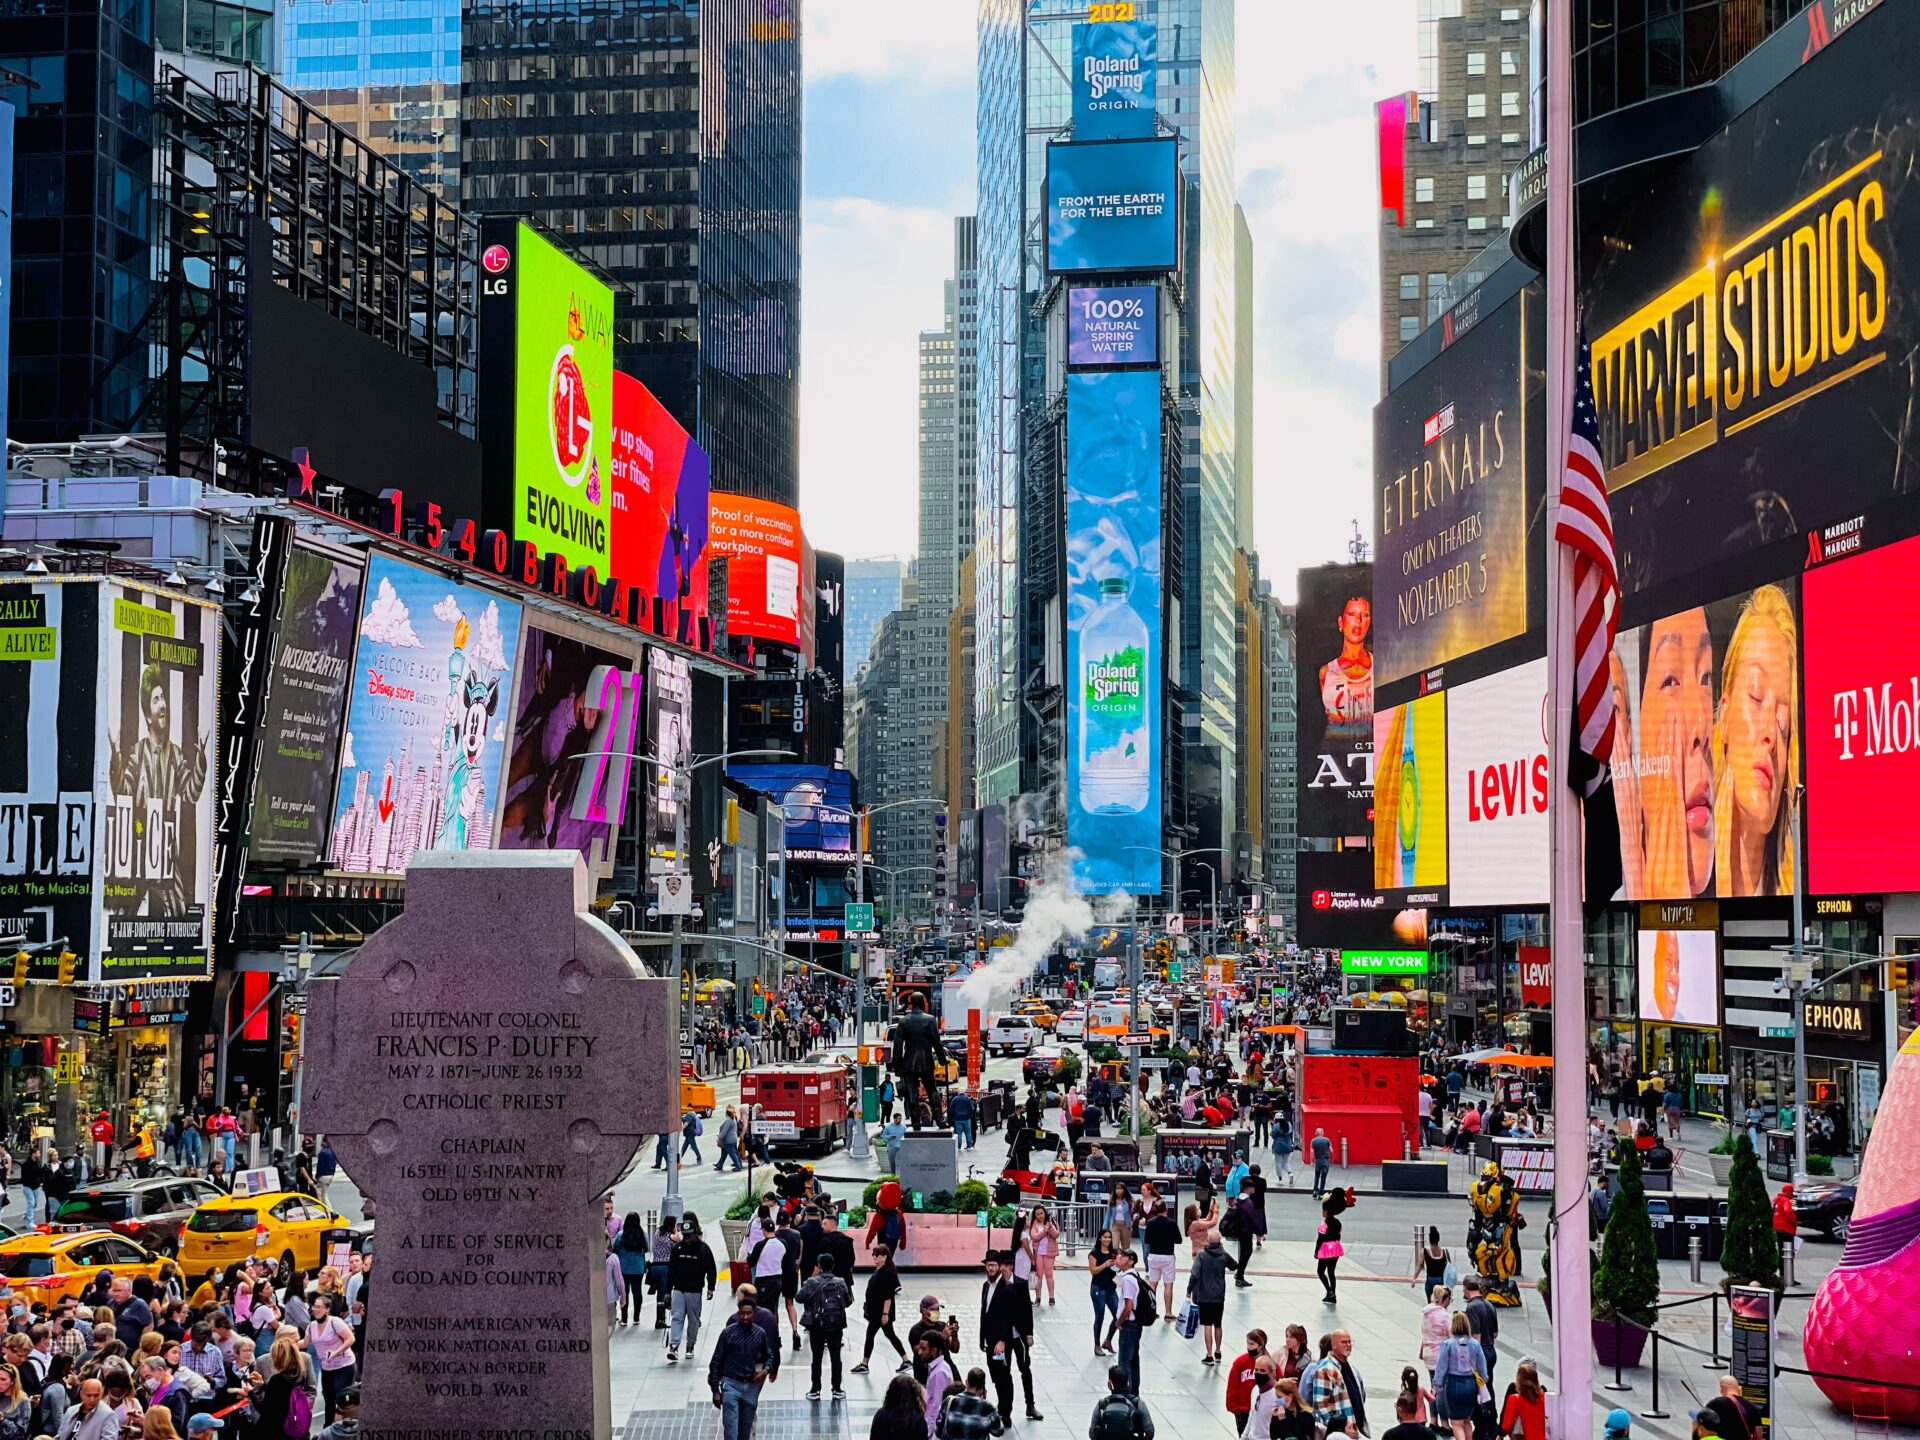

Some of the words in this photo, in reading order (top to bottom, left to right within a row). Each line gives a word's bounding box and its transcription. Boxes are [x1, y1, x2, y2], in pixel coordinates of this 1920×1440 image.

[1088, 2, 1134, 23] 2021
[1084, 53, 1139, 83] Poland
[1090, 70, 1143, 99] Spring
[1088, 100, 1139, 111] ORIGIN
[1058, 196, 1094, 208] FROM
[1096, 195, 1121, 206] THE
[1124, 193, 1165, 205] EARTH
[1060, 207, 1087, 219] FOR
[1089, 206, 1114, 218] THE
[1116, 205, 1163, 217] BETTER
[483, 279, 508, 295] LG
[1454, 289, 1481, 316] MARRIOTT
[1723, 181, 1886, 412] STUDIOS
[1082, 299, 1144, 320] 100%
[1085, 321, 1140, 333] NATURAL
[1454, 310, 1478, 335] MARQUIS
[1091, 331, 1134, 343] SPRING
[1092, 342, 1134, 353] WATER
[1596, 288, 1714, 473] MARVEL
[620, 429, 635, 451] up
[635, 432, 654, 464] strong
[1382, 410, 1504, 537] ETERNALS
[527, 486, 605, 555] EVOLVING
[711, 506, 741, 522] Proof
[743, 511, 753, 523] of
[755, 515, 793, 533] vaccination
[1825, 516, 1864, 540] MARRIOTT
[711, 522, 727, 535] for
[729, 526, 737, 536] a
[739, 528, 764, 541] more
[765, 530, 794, 548] confident
[1402, 543, 1426, 576] ONLY
[1427, 538, 1436, 563] IN
[1438, 511, 1483, 558] THEATERS
[711, 539, 764, 559] workplace
[1825, 535, 1860, 557] MARQUIS
[1398, 565, 1473, 630] NOVEMBER
[1479, 553, 1488, 594] 5
[119, 605, 146, 631] RAISING
[147, 612, 171, 636] SPIRITS
[5, 633, 51, 653] ALIVE!
[150, 639, 160, 660] ON
[160, 642, 197, 668] BROADWAY!
[371, 652, 415, 677] WELCOME
[418, 664, 442, 683] BACK
[1088, 663, 1136, 686] Poland
[395, 685, 414, 702] store
[1094, 678, 1140, 702] Spring
[370, 703, 394, 719] VISIT
[399, 706, 430, 728] TODAY!
[1092, 704, 1137, 712] ORIGIN
[1631, 752, 1671, 779] Makeup
[24, 882, 45, 895] The
[1331, 898, 1359, 911] Apple
[1816, 900, 1852, 913] SEPHORA
[118, 921, 165, 938] JAW-DROPPING
[1352, 956, 1386, 967] NEW
[1388, 956, 1423, 967] YORK
[136, 981, 190, 1000] LUGGAGE
[150, 1014, 170, 1023] SONY
[390, 1012, 493, 1030] LIEUTENANT
[498, 1012, 581, 1029] COLONEL
[1804, 1004, 1862, 1031] EPHORA
[1767, 1028, 1774, 1037] W
[1777, 1028, 1786, 1037] 46
[375, 1035, 478, 1058] FRANCIS
[512, 1035, 599, 1058] DUFFY
[59, 1054, 68, 1079] ATM
[388, 1065, 421, 1079] MAY
[425, 1065, 434, 1079] 2
[526, 1065, 544, 1079] 26
[549, 1065, 583, 1079] 1932
[403, 1094, 491, 1110] CATHOLIC
[503, 1094, 566, 1110] PRIEST
[441, 1138, 526, 1154] CHAPLAIN
[1200, 1137, 1226, 1146] proud
[401, 1165, 447, 1180] 165TH
[422, 1187, 457, 1201] OLD
[463, 1187, 500, 1201] 69TH
[401, 1234, 412, 1250] A
[421, 1234, 455, 1250] LIFE
[463, 1234, 486, 1250] OF
[493, 1234, 565, 1250] SERVICE
[466, 1253, 495, 1266] FOR
[392, 1270, 434, 1286] GOD
[438, 1270, 478, 1286] AND
[484, 1270, 570, 1286] COUNTRY
[386, 1317, 448, 1331] SPANISH
[451, 1317, 532, 1331] AMERICAN
[536, 1317, 572, 1331] WAR
[366, 1339, 402, 1353] NEW
[405, 1339, 446, 1353] YORK
[452, 1339, 528, 1353] NATIONAL
[535, 1339, 590, 1353] GUARD
[407, 1361, 480, 1375] MEXICAN
[484, 1361, 547, 1375] BORDER
[424, 1383, 483, 1397] WORLD
[493, 1383, 529, 1397] WAR
[359, 1429, 472, 1440] DISTINGUISHED
[477, 1429, 536, 1440] SERVICE
[543, 1429, 592, 1440] CROSS
